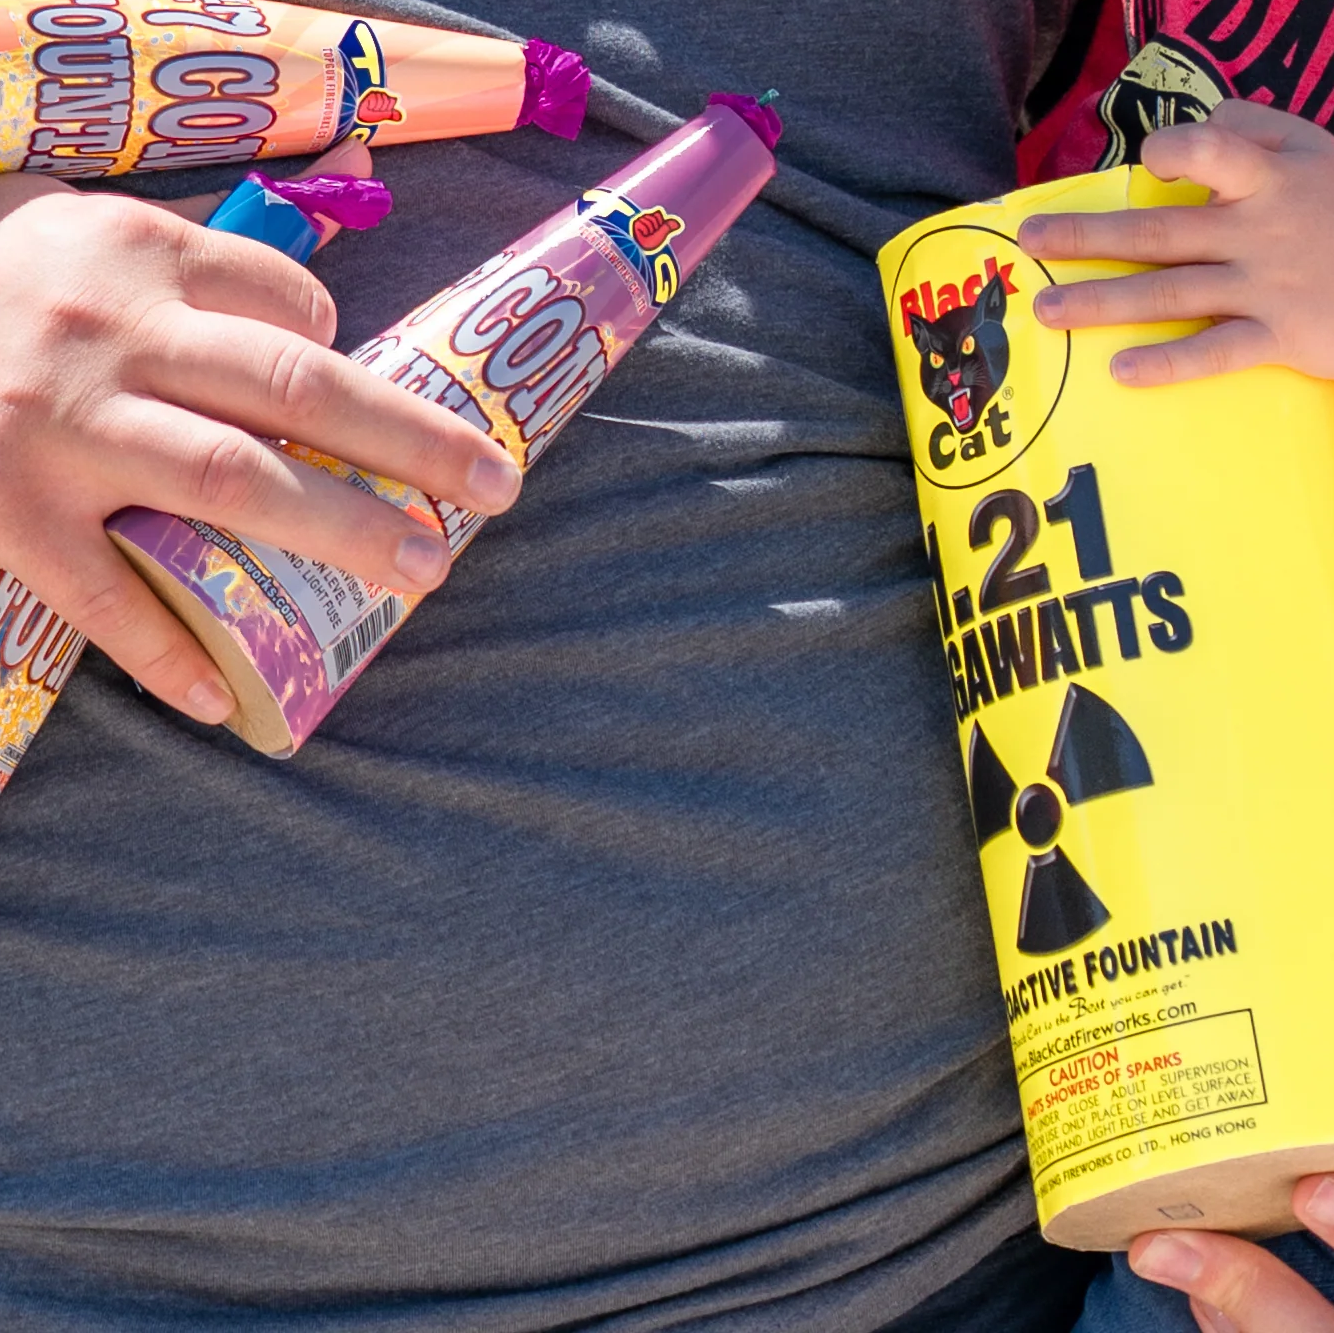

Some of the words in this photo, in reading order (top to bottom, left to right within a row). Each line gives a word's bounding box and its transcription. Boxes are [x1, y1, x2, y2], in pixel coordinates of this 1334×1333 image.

[322, 47, 335, 81] TOPGUN
[899, 256, 1019, 338] Black
[450, 265, 609, 458] CON
[929, 402, 1012, 471] Cat
[181, 515, 299, 627] .topgunfireworks.com
[279, 544, 307, 574] AND.
[300, 568, 329, 603] LIGHT
[323, 599, 342, 630] FUSE
[322, 570, 348, 607] LEVEL
[1083, 918, 1237, 988] FOUNTAIN
[1053, 1012, 1071, 1026] the
[1066, 989, 1106, 1020] Best
[1109, 993, 1132, 1010] you
[1134, 986, 1158, 1000] can
[1043, 1074, 1101, 1108] SHOWERS
[1101, 1066, 1123, 1086] OF
[1125, 1050, 1183, 1079] SPARKS
[1047, 1046, 1119, 1086] CAUTION
[1066, 1093, 1100, 1117] CLOSE
[1108, 1078, 1147, 1100] ADULT
[1085, 1121, 1117, 1142] LIGHT
[1119, 1111, 1149, 1130] FUSE
[1150, 1102, 1181, 1122] AND
[1184, 1094, 1211, 1112] GET
[1089, 1101, 1123, 1123] PLACE
[1126, 1095, 1148, 1112] ON
[1150, 1085, 1186, 1105] LEVEL
[1061, 1153, 1114, 1182] FIREWORKS
[1169, 1125, 1211, 1146] HONG
[1214, 1116, 1257, 1136] KONG
